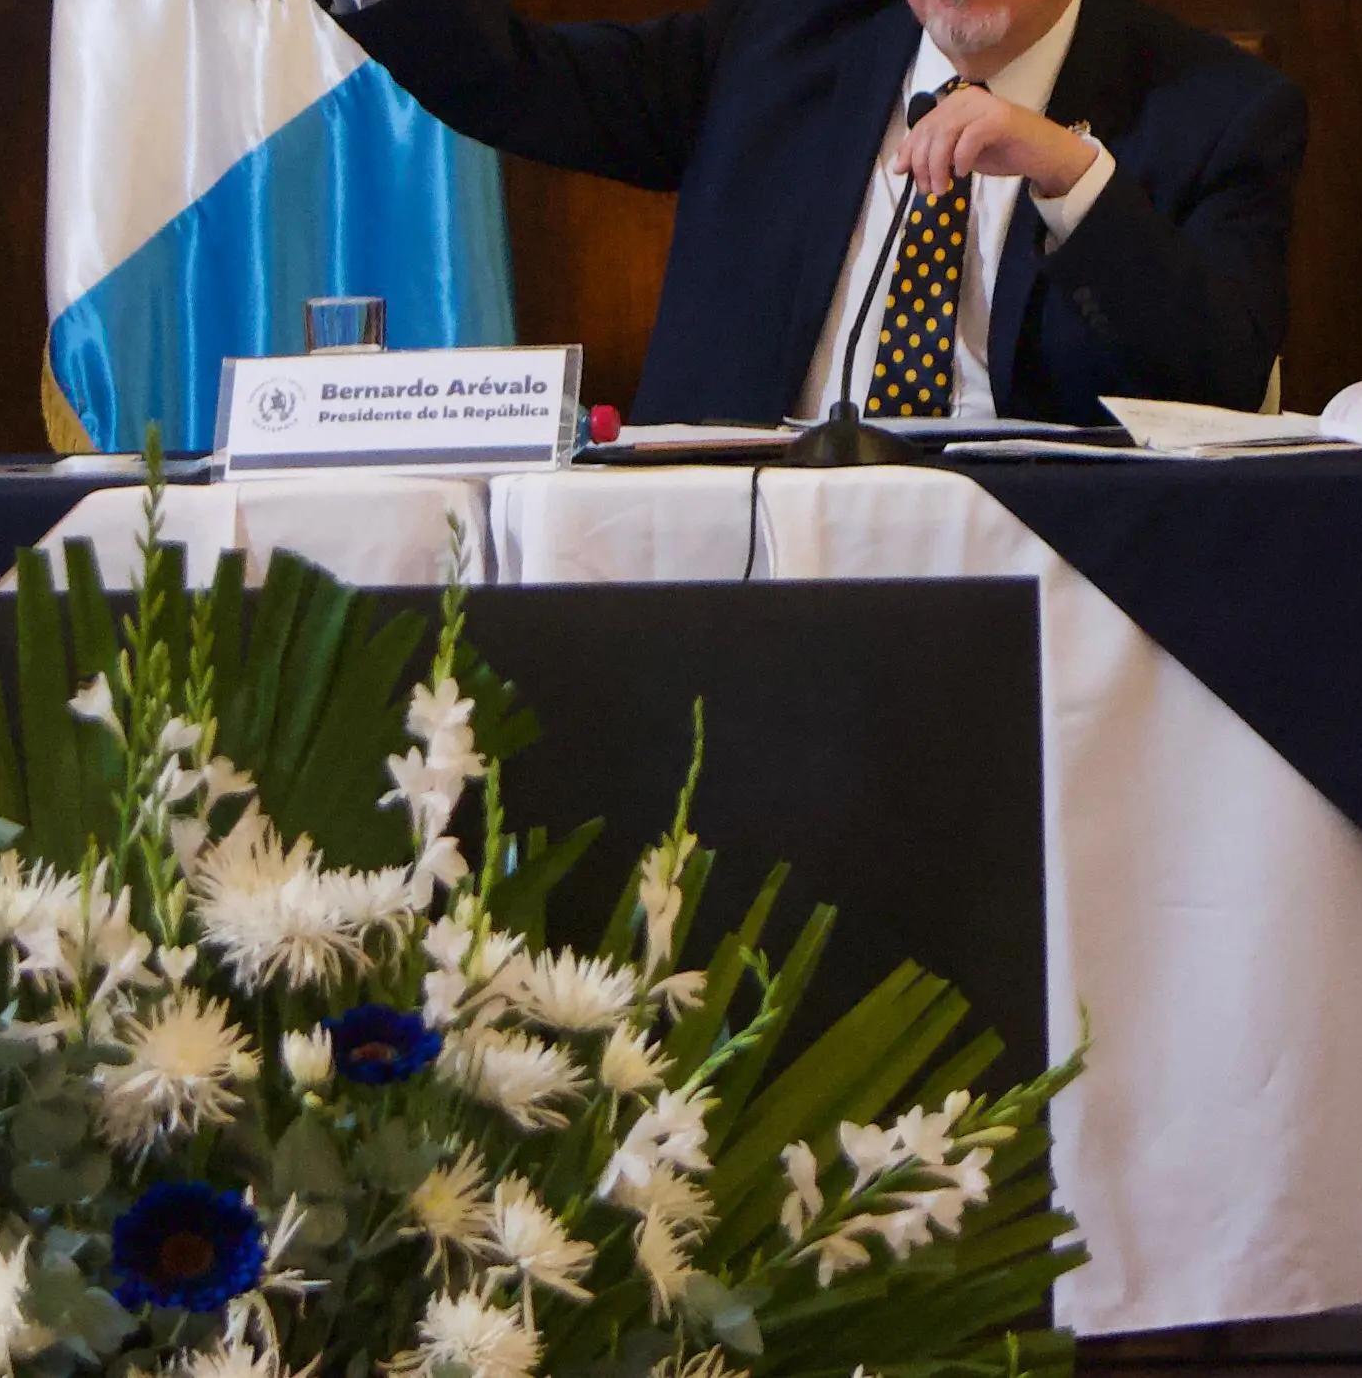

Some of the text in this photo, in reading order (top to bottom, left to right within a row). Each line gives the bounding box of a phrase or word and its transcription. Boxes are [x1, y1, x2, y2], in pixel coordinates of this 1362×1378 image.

[321, 375, 548, 400] Bernardo Arévalo
[318, 403, 549, 423] Presidente de la República
